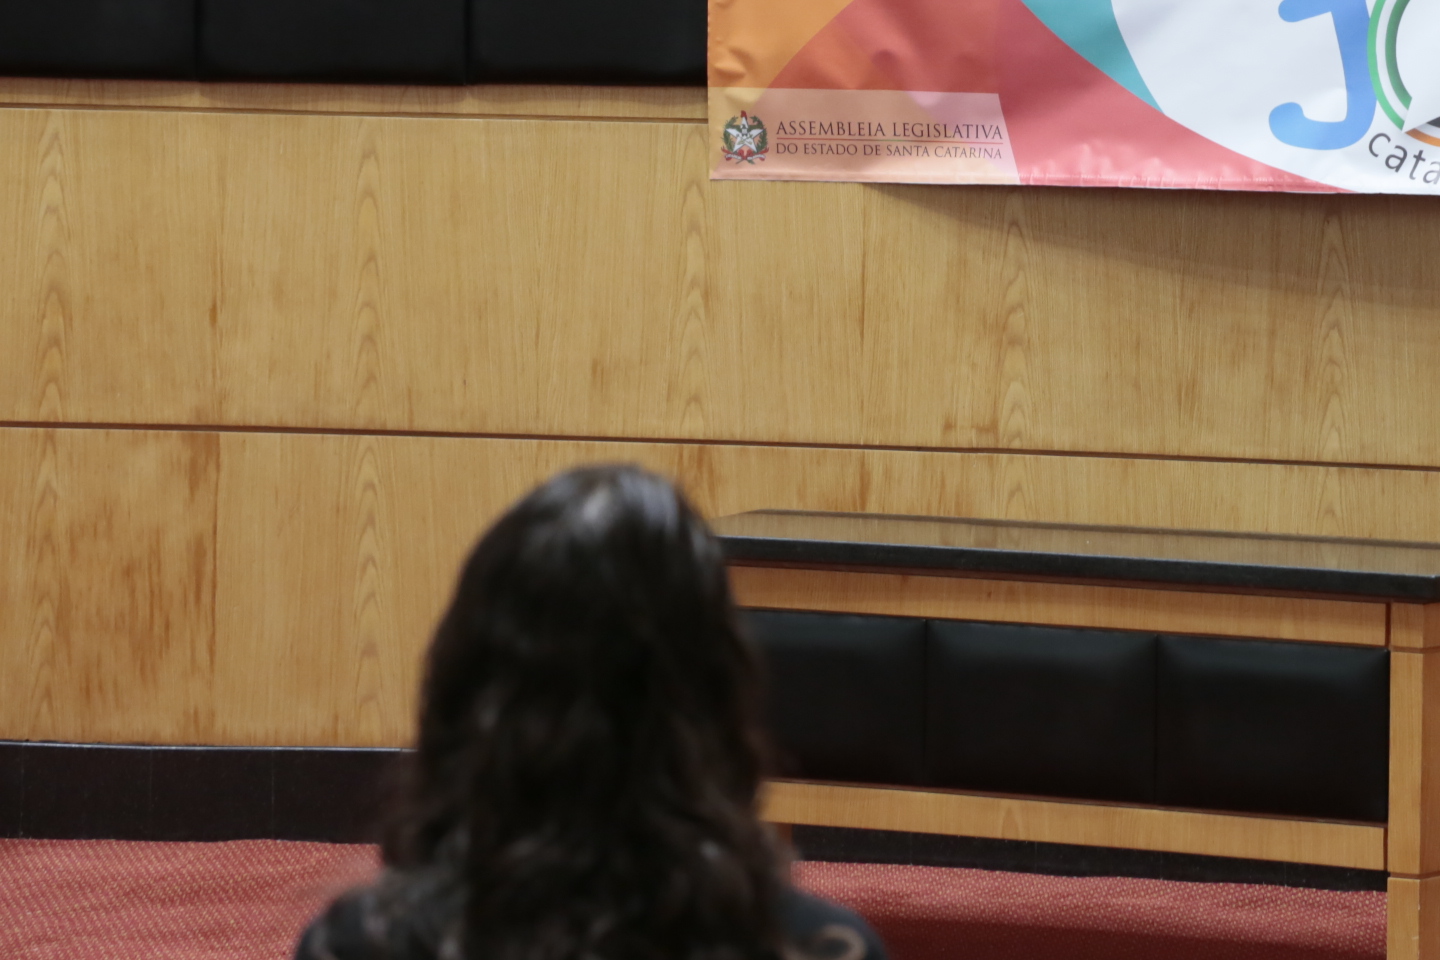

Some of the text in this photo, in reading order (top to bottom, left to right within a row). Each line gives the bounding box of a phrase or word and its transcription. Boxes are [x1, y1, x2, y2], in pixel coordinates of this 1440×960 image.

[776, 120, 1003, 140] ASSEMBLEIA LEGISLATIVA
[776, 142, 1003, 160] DO ESTADO DE SANTA CATARINA
